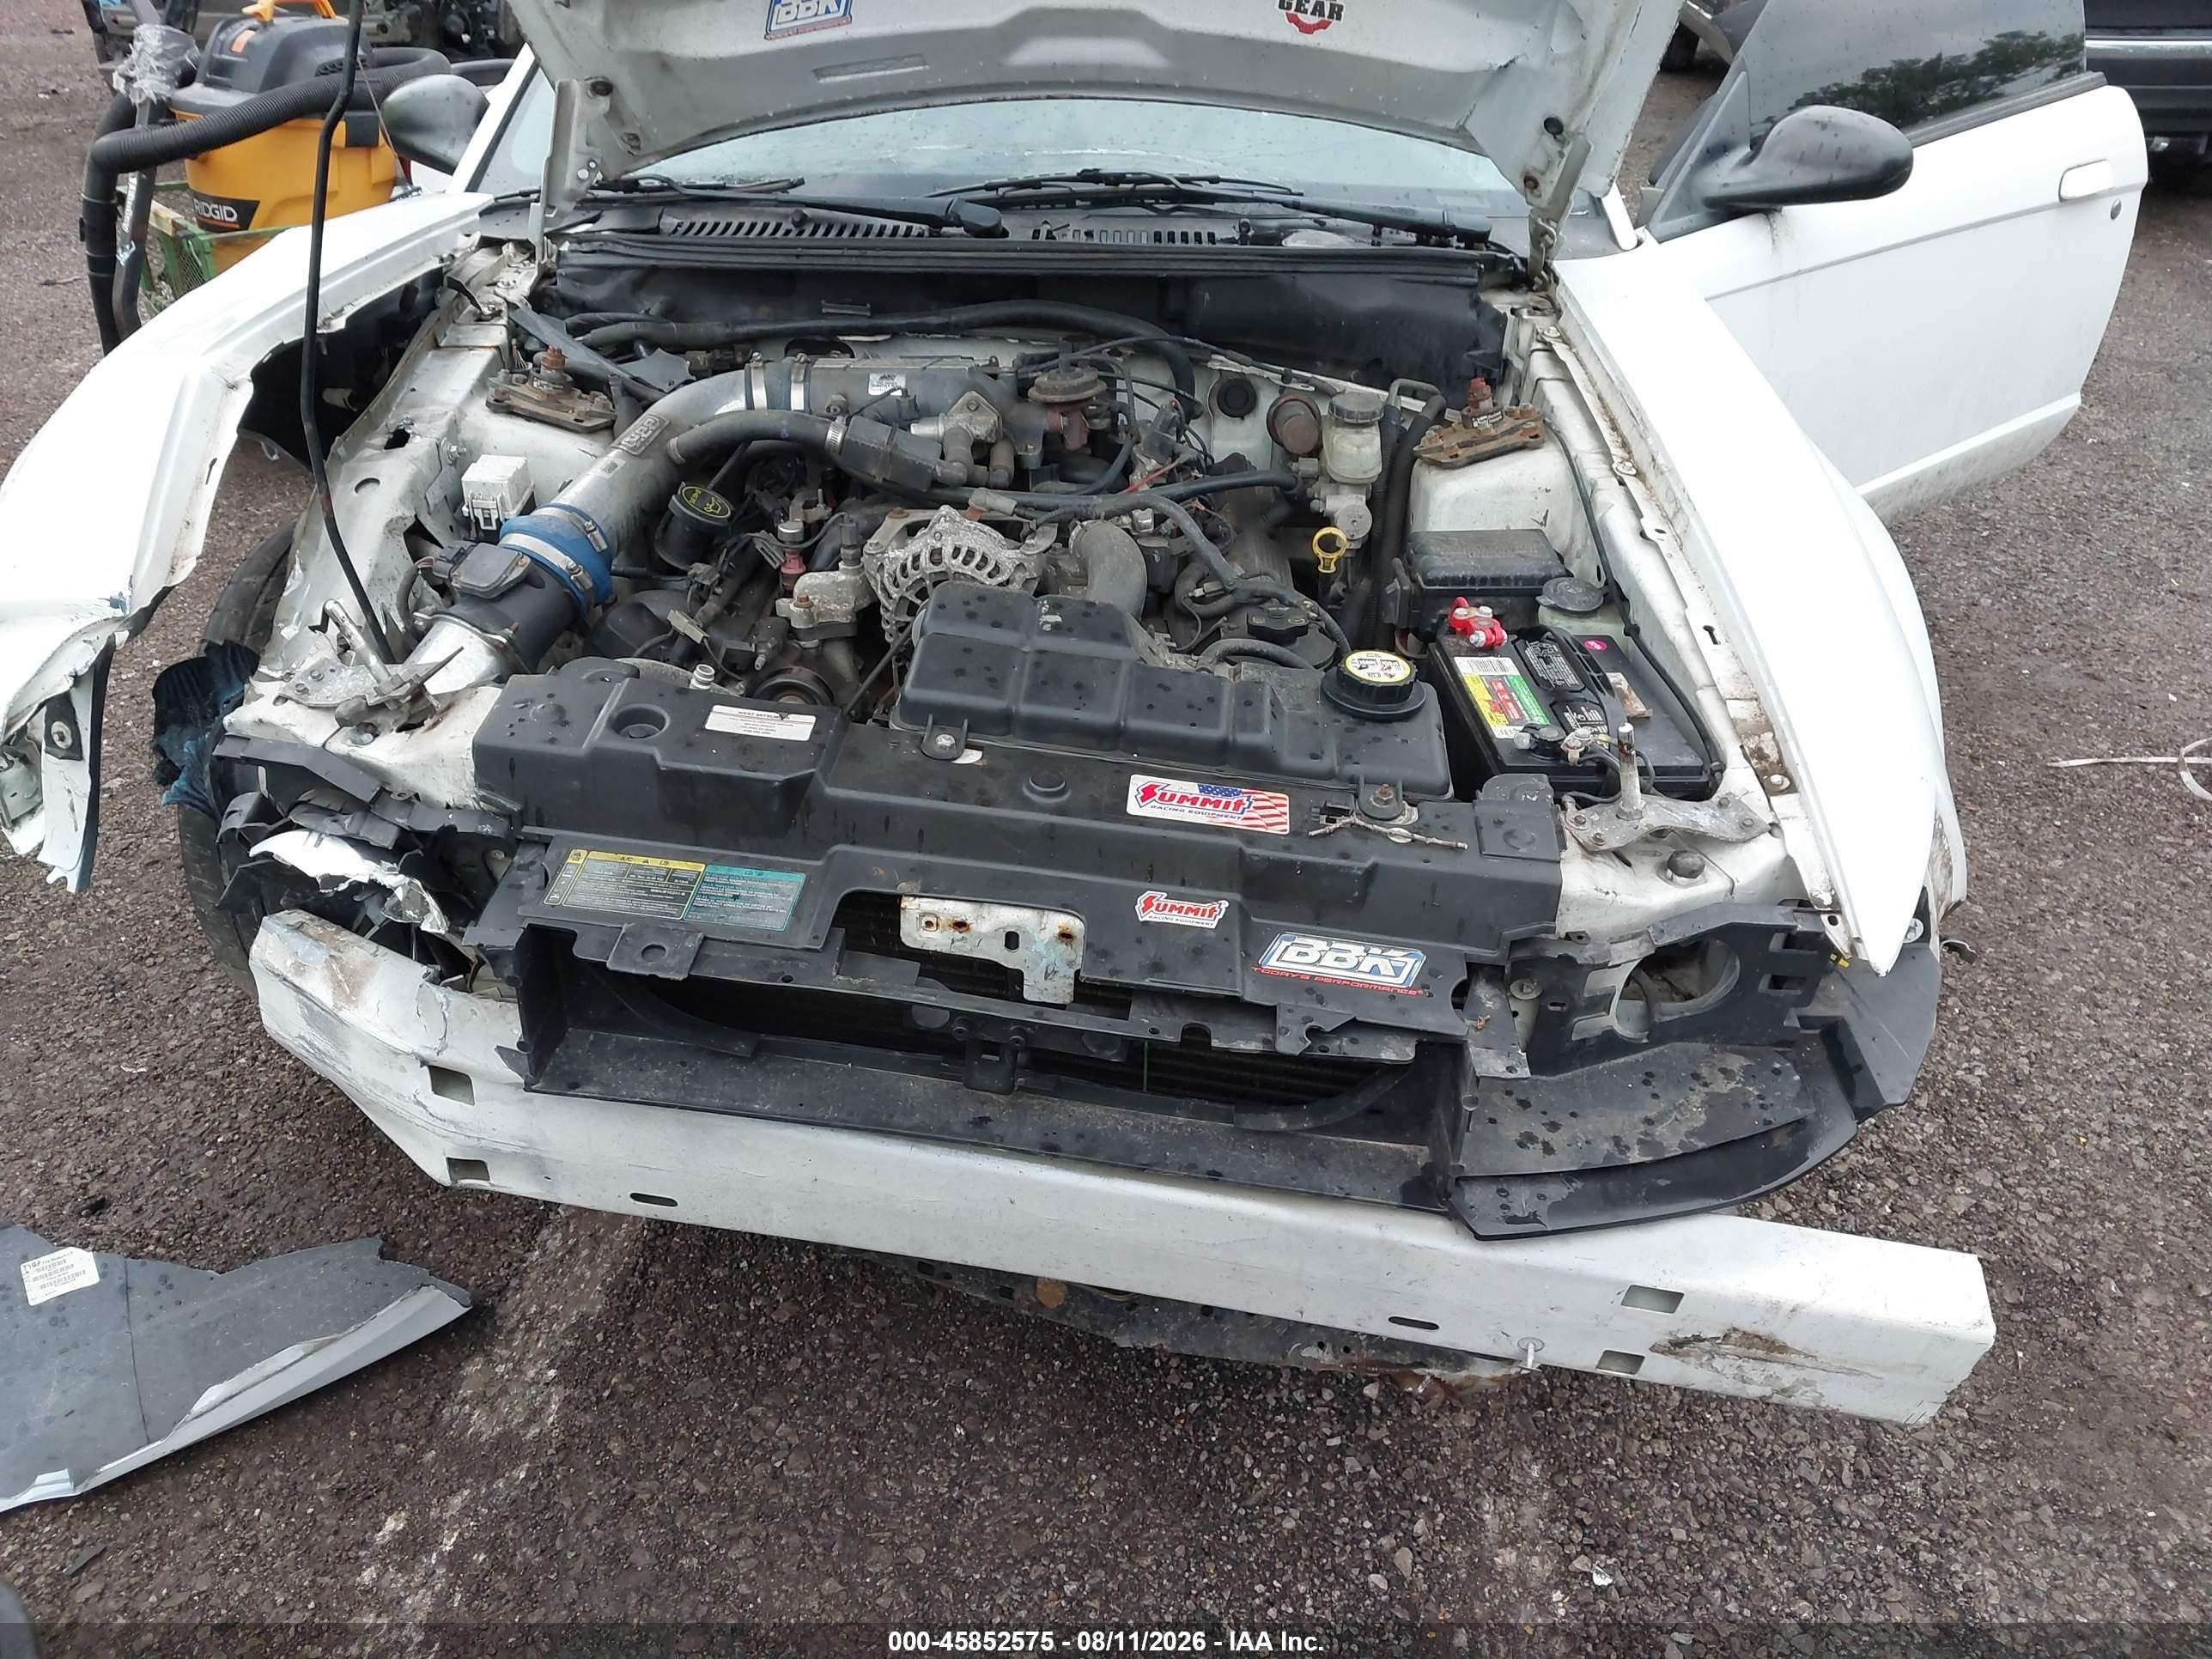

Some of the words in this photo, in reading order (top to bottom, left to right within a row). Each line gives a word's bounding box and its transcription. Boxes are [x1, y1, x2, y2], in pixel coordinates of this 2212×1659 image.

[193, 198, 238, 222] RIDGID
[1140, 783, 1246, 812] SUMMIT
[1150, 805, 1186, 813] RACING
[1188, 809, 1243, 820] EQUIPMENT
[1141, 894, 1218, 918] SUMMIT
[1175, 918, 1215, 927] EQUIPMENT
[1276, 937, 1409, 977] BBK
[1251, 966, 1310, 980] TODAY'S
